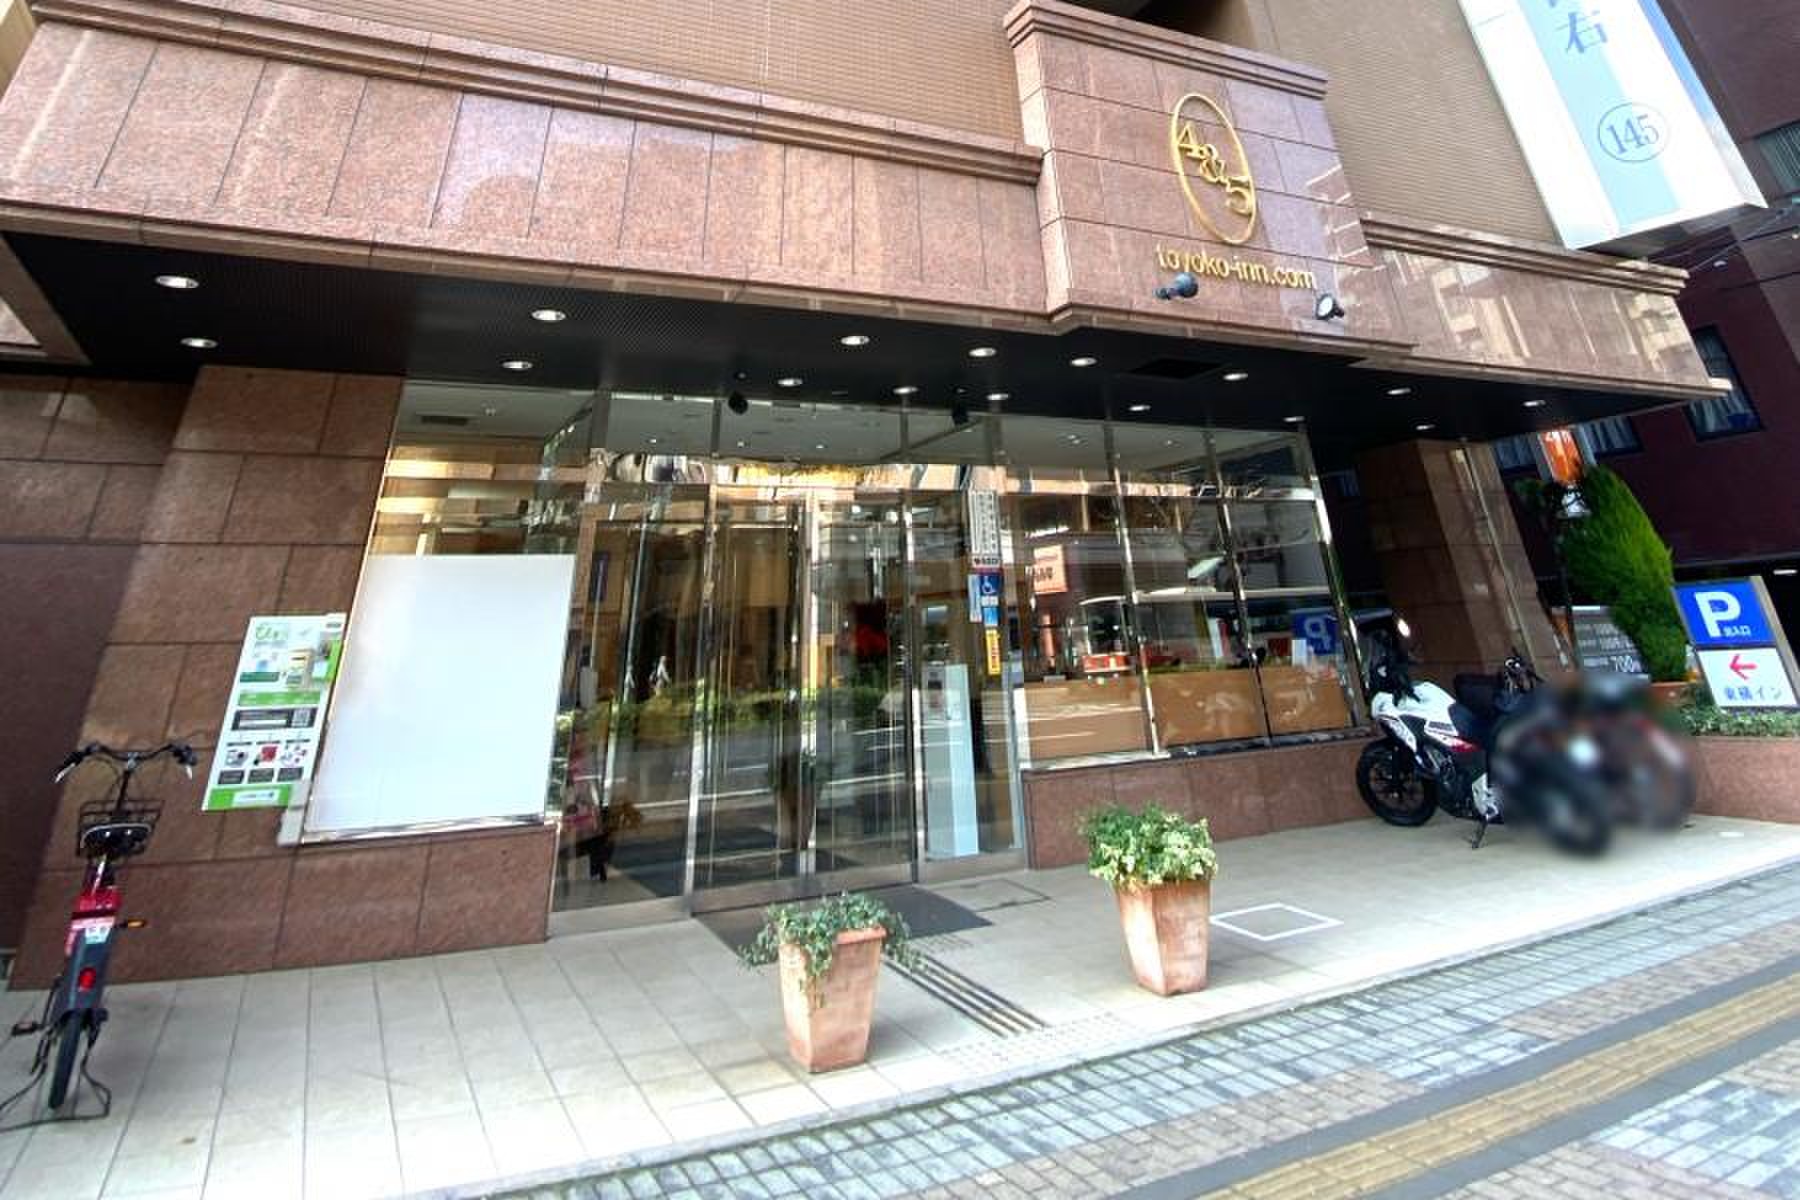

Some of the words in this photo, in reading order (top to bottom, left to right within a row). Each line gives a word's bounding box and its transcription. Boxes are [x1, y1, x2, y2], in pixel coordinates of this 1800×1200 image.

[1606, 113, 1660, 155] 145
[1156, 243, 1317, 289] toyoko-inn.com
[1694, 590, 1741, 638] P
